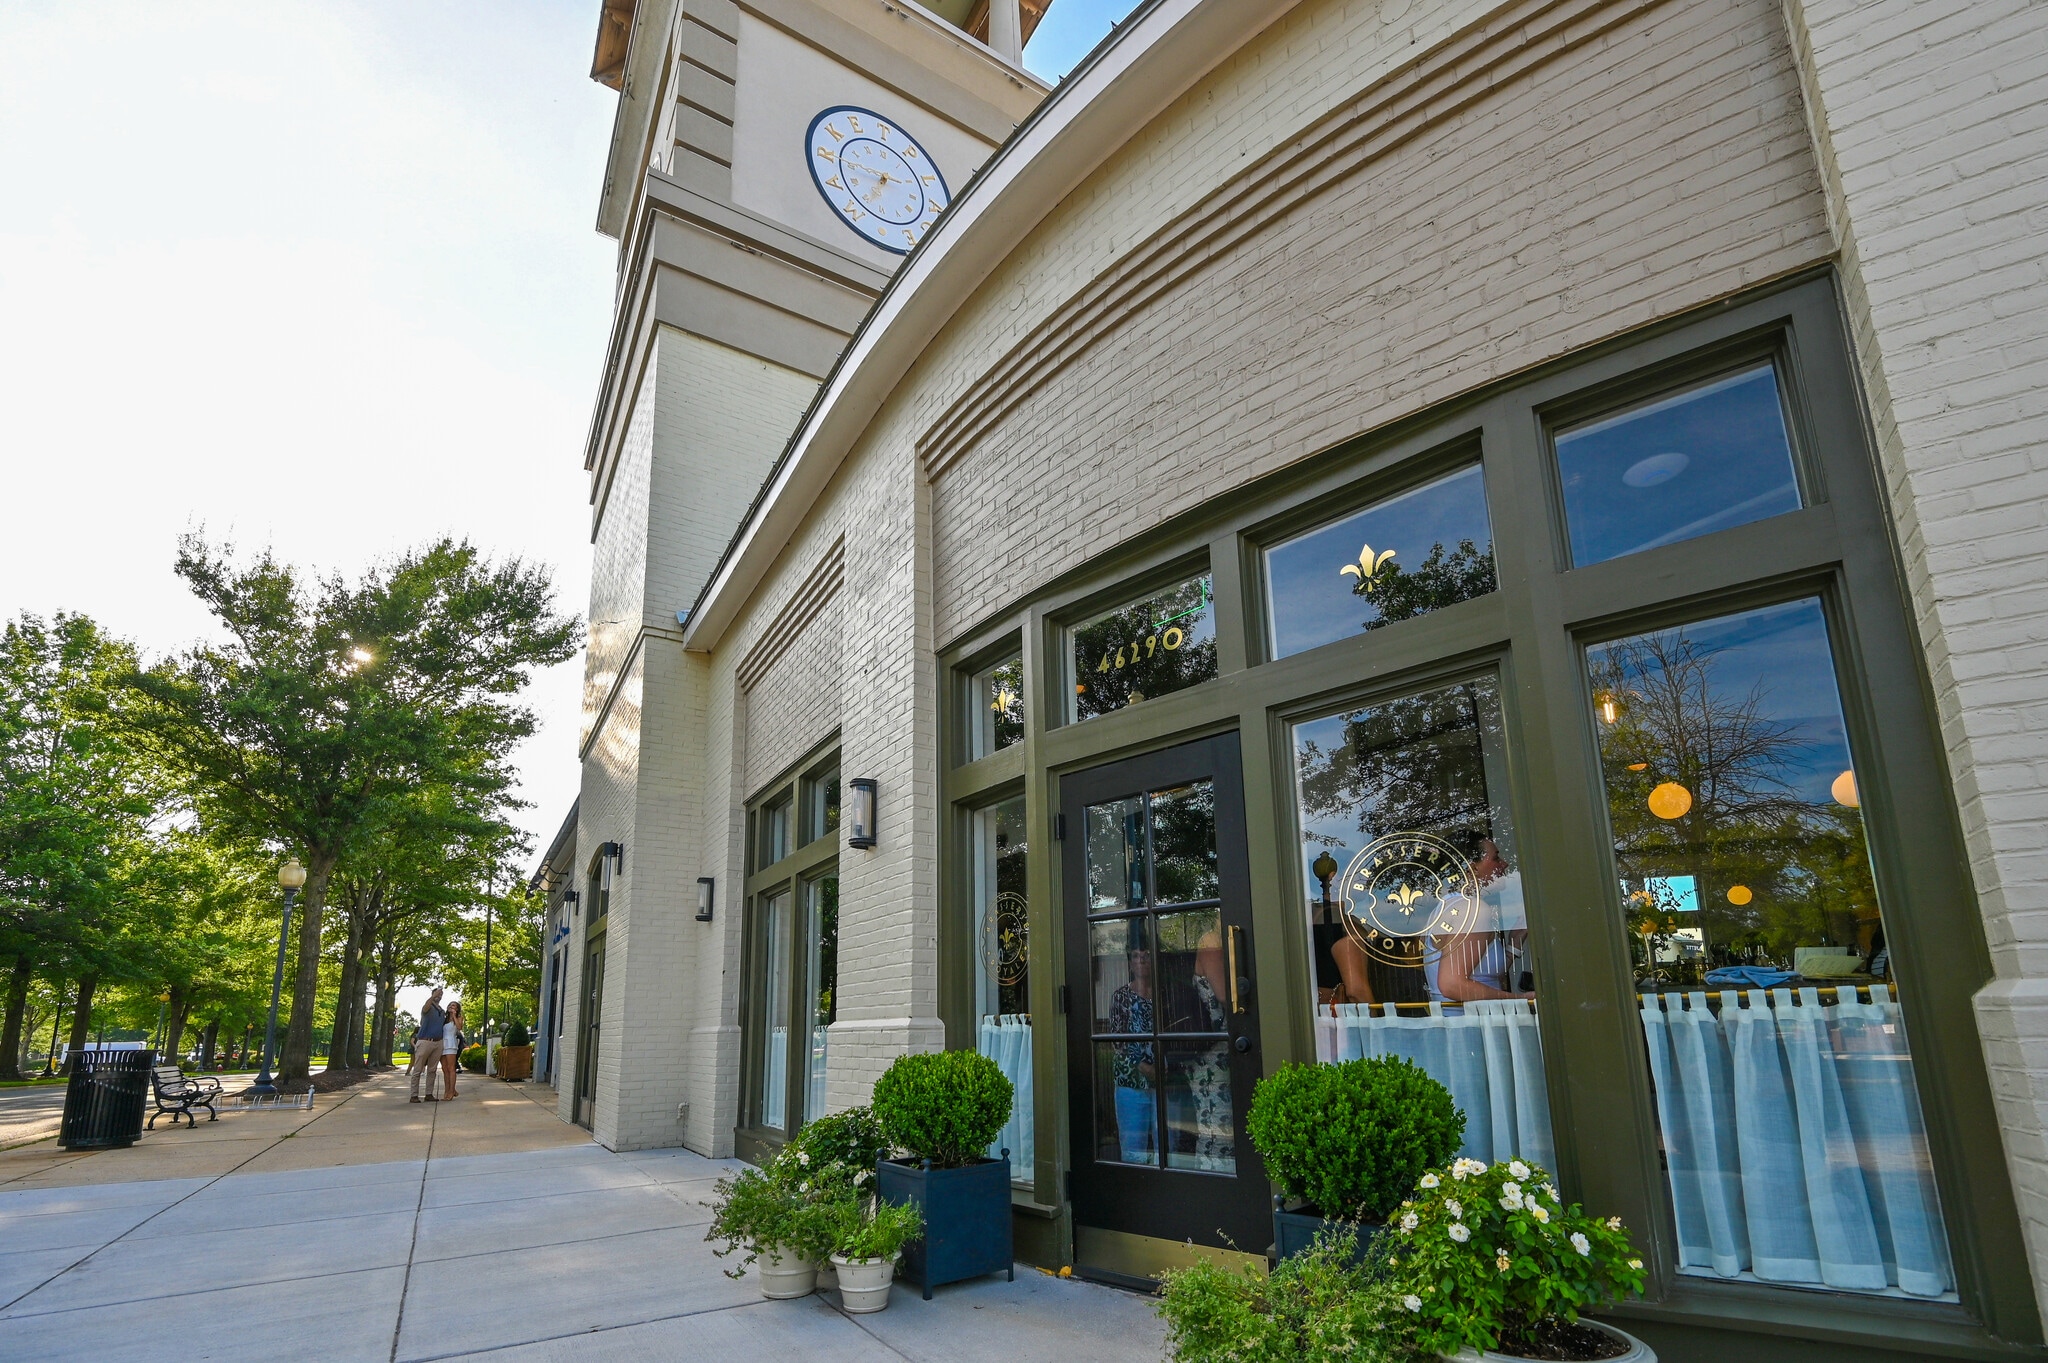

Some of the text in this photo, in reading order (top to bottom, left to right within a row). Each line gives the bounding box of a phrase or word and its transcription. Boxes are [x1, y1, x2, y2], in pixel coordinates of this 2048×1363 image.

[817, 115, 891, 222] MARKET
[1097, 627, 1183, 674] 46290
[1353, 845, 1460, 892] BRASSERIE
[1367, 921, 1454, 953] ROYALE
